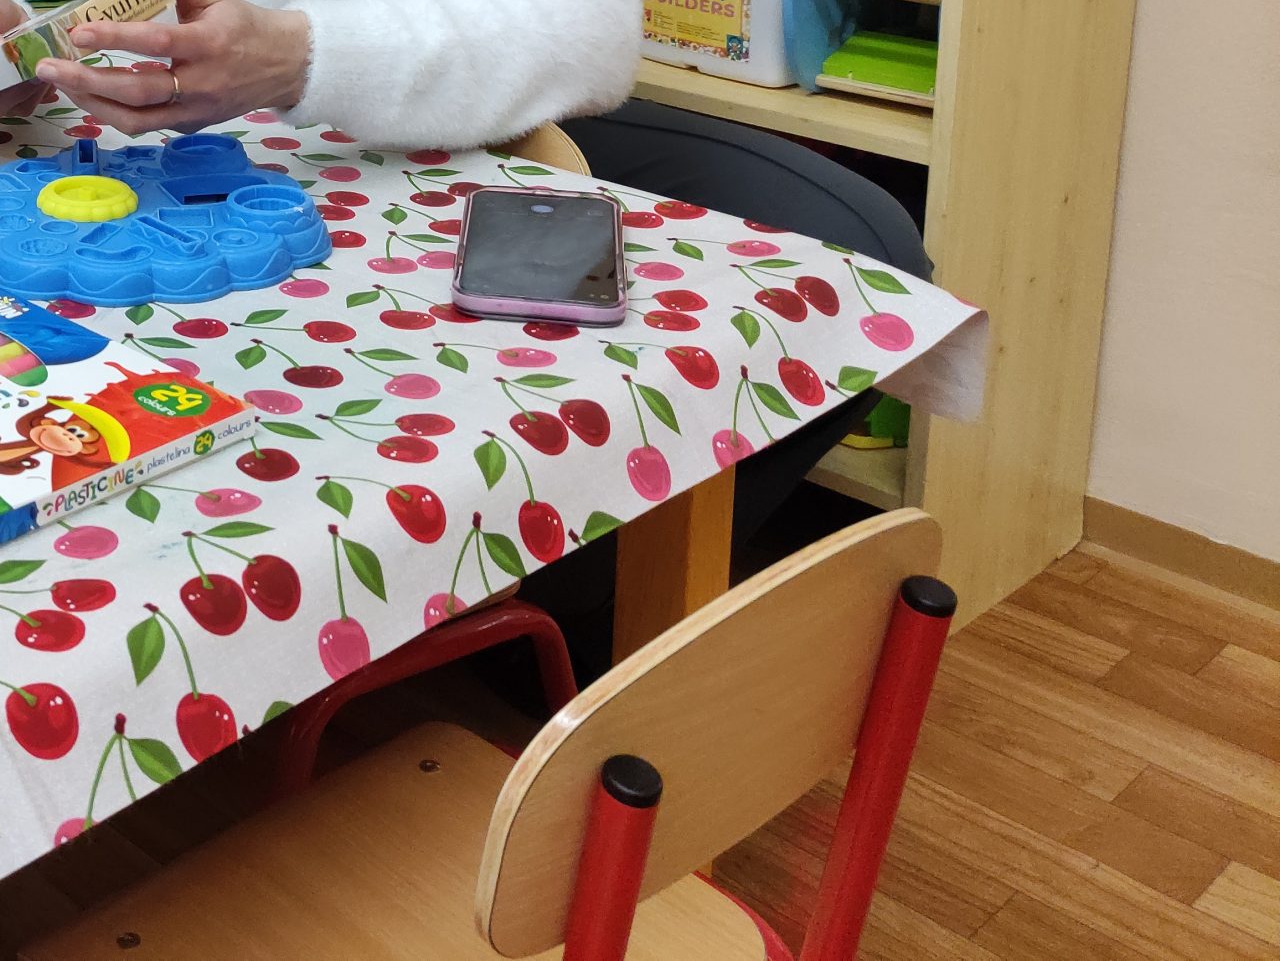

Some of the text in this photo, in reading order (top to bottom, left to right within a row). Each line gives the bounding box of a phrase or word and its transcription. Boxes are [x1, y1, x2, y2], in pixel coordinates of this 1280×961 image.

[136, 395, 176, 417] colours
[151, 384, 202, 412] 24
[54, 419, 252, 513] PLASTICINE plastelina 24 colours
